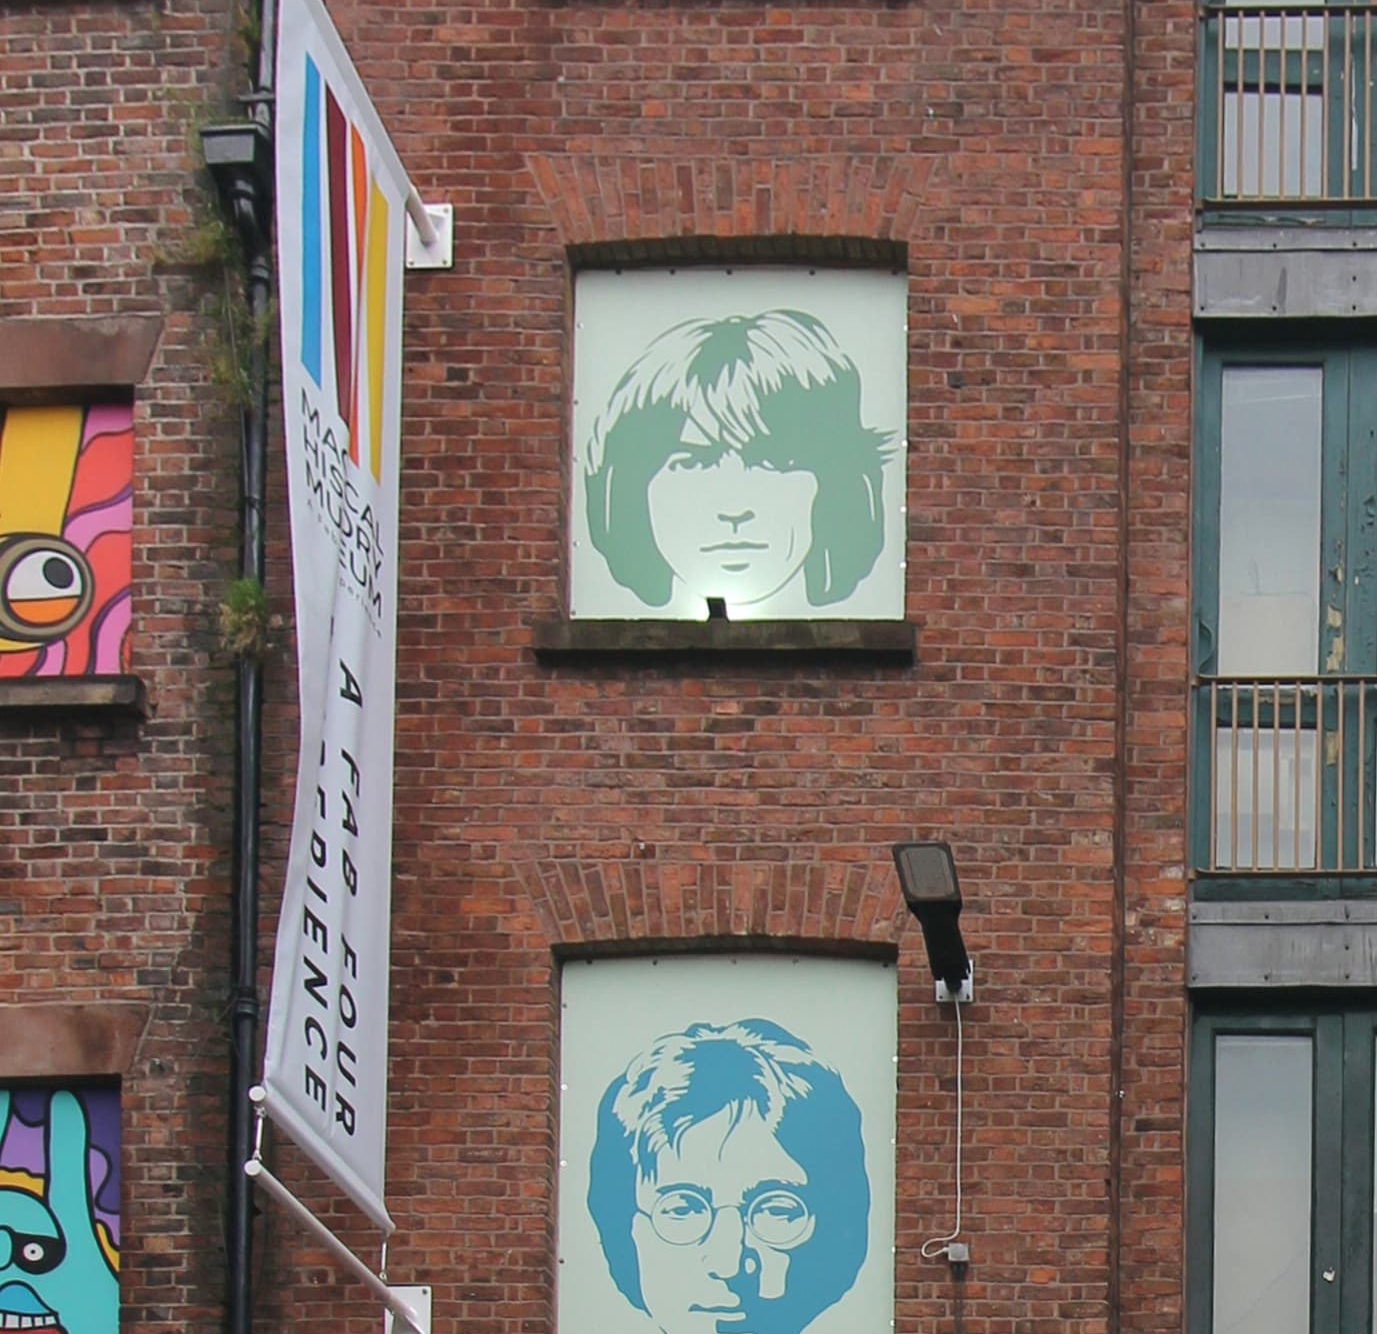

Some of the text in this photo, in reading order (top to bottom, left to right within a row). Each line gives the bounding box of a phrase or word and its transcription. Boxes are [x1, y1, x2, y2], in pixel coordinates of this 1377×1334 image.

[339, 658, 364, 710] A
[339, 747, 361, 898] FAB
[334, 930, 358, 1138] FOUR
